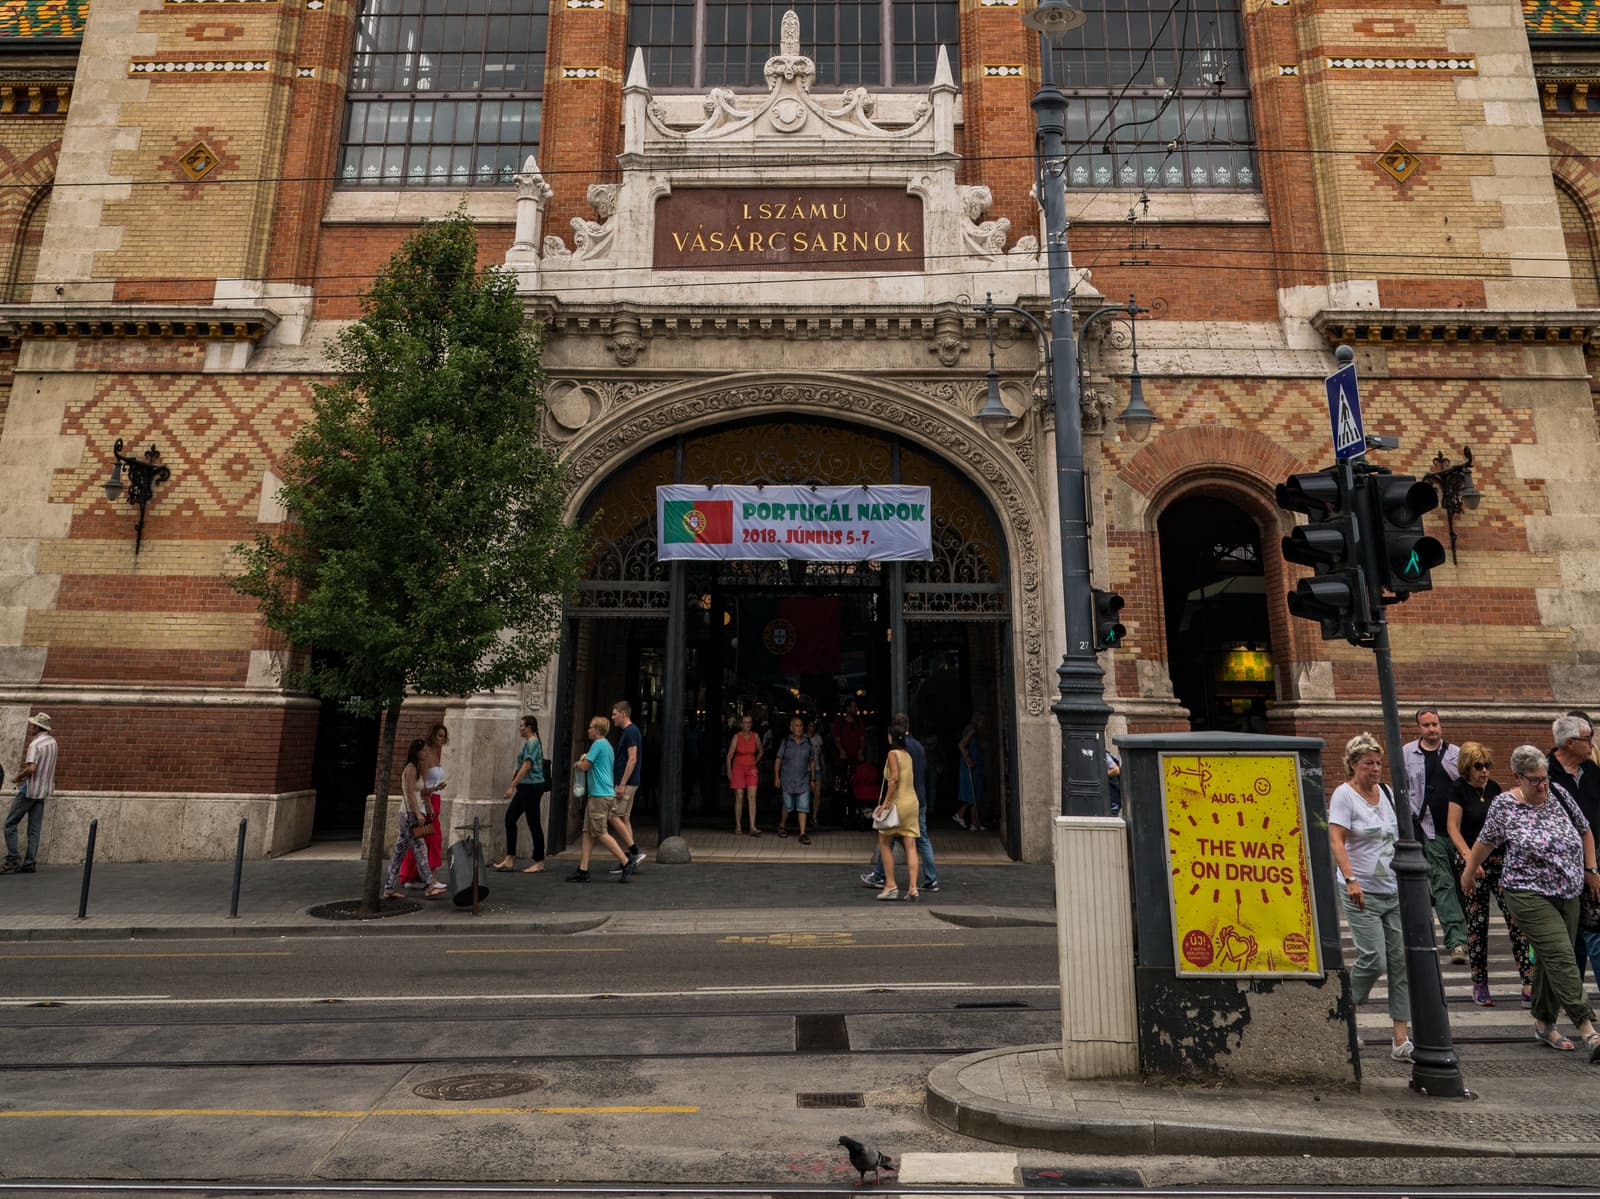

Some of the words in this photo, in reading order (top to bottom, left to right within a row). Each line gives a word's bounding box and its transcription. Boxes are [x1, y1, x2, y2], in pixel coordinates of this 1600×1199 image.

[743, 204, 752, 219] I.
[759, 197, 848, 220] SZÁMÚ
[672, 224, 913, 252] VÁSÁRCSARNOK
[742, 500, 853, 522] PORTUGÁL
[857, 502, 926, 522] NAPOK
[742, 528, 781, 544] 2018.
[785, 526, 843, 544] JÚNIUS
[846, 530, 875, 545] 5-7.
[1079, 641, 1089, 650] 27
[1211, 793, 1239, 804] AUG.
[1241, 793, 1258, 804] 14.
[1196, 838, 1237, 858] THE
[1240, 841, 1286, 861] WAR
[1191, 861, 1220, 880] ON
[1225, 863, 1294, 885] DRUGS
